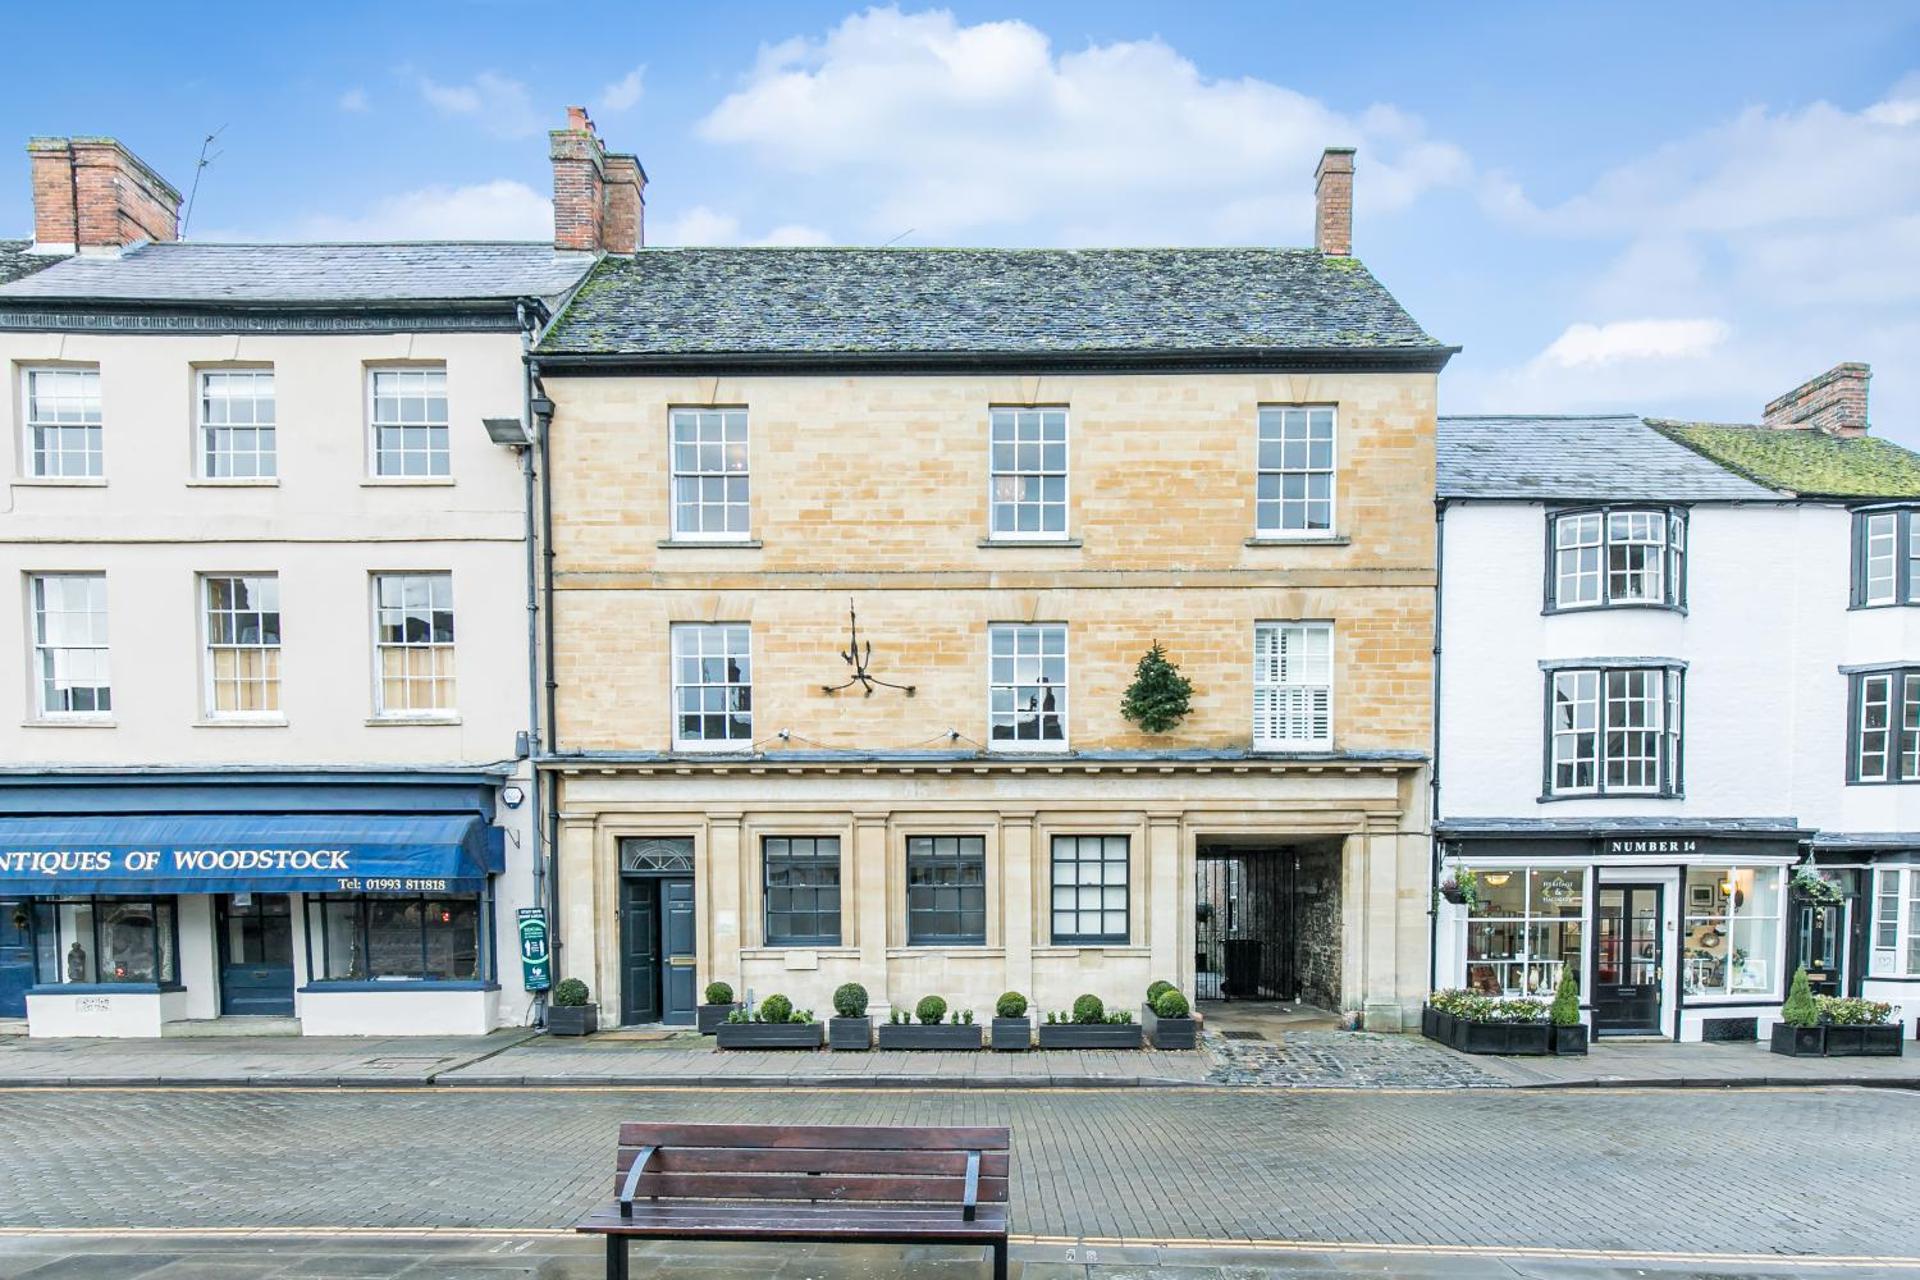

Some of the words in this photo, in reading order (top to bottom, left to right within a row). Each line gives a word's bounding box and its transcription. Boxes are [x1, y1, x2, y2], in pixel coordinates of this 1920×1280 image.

[1611, 841, 1679, 852] NUMBER
[1683, 840, 1696, 851] 14
[0, 851, 111, 874] NTIQUES
[125, 851, 161, 871] OF
[174, 850, 350, 870] WOODSTOCK
[338, 878, 362, 890] Tel:
[366, 879, 402, 890] 01993
[405, 880, 446, 890] 811818
